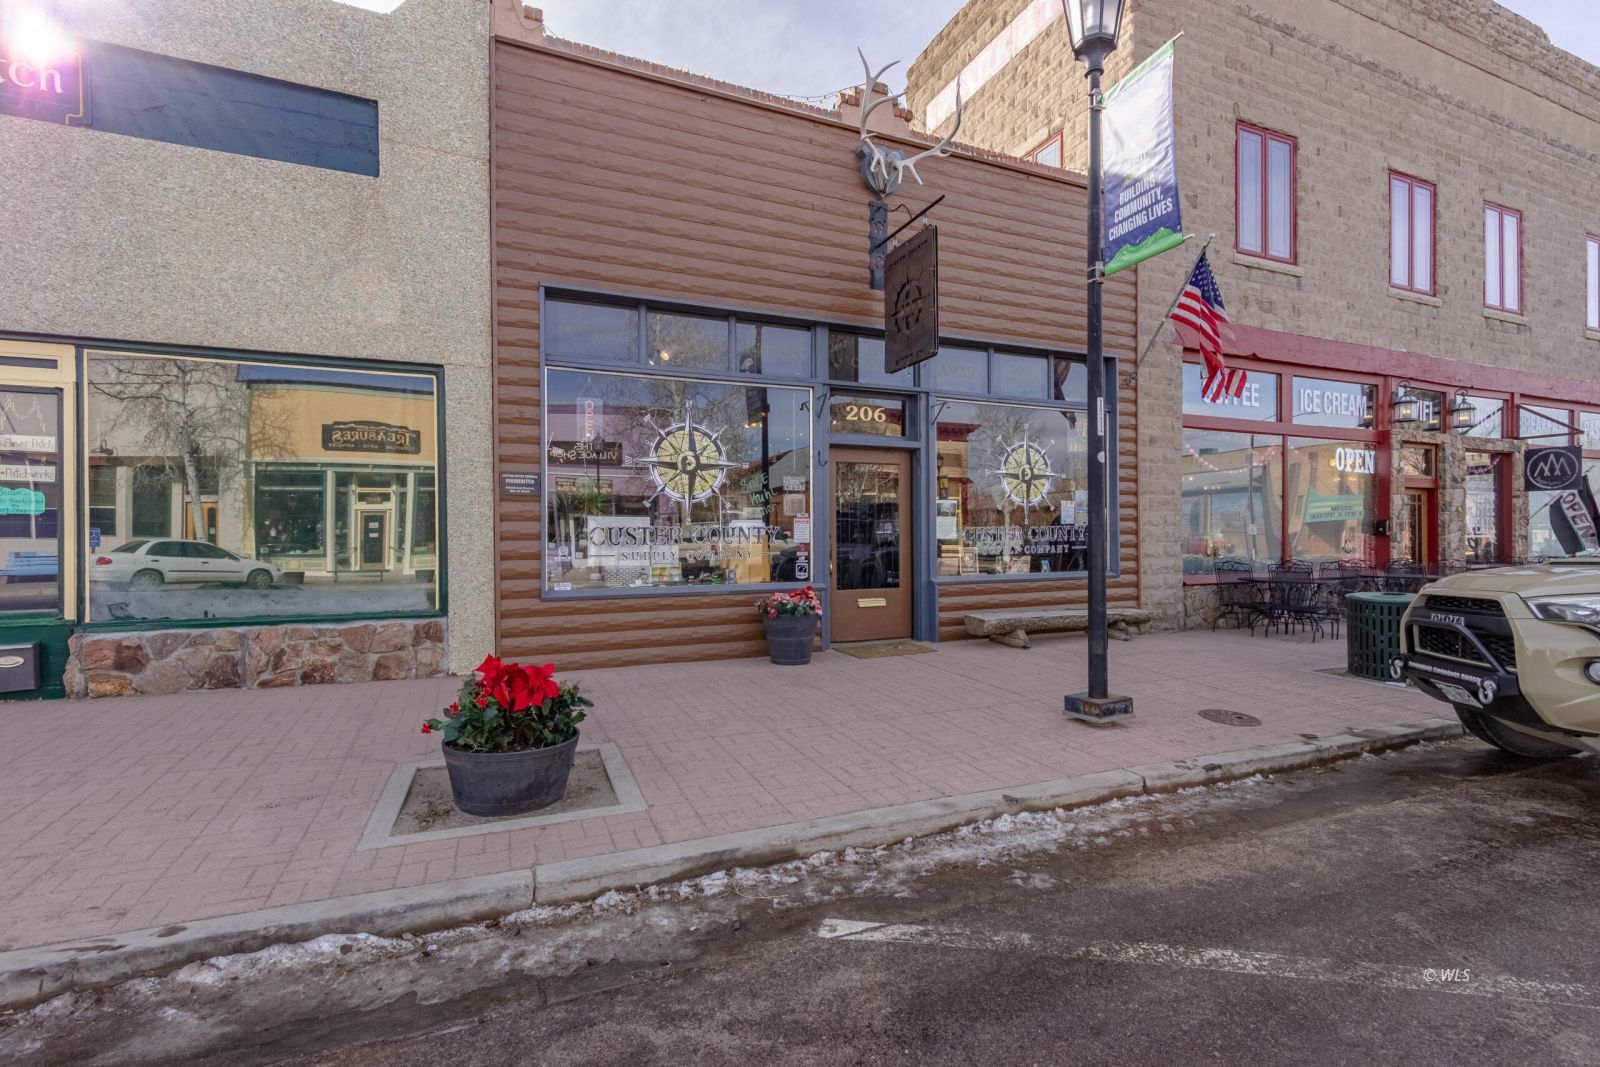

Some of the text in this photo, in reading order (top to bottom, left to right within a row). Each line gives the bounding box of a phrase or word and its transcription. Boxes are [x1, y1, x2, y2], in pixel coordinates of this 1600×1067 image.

[1119, 174, 1156, 206] BUILDING
[1114, 186, 1164, 223] COMMUNITY,
[1108, 197, 1173, 241] CHANGING LIVES
[846, 405, 887, 423] 206
[1300, 388, 1368, 417] ICE CREAM
[1417, 400, 1433, 423] IFI
[1335, 447, 1376, 474] OPEN
[1562, 492, 1596, 538] OPEN
[589, 526, 684, 546] CUSTER
[691, 525, 780, 546] COUNTY
[962, 525, 1088, 543] CUSTER COUNTY
[621, 549, 753, 561] SUPPLY COMPANY
[1024, 544, 1070, 554] COMPANY
[1430, 613, 1465, 626] TOYOTA
